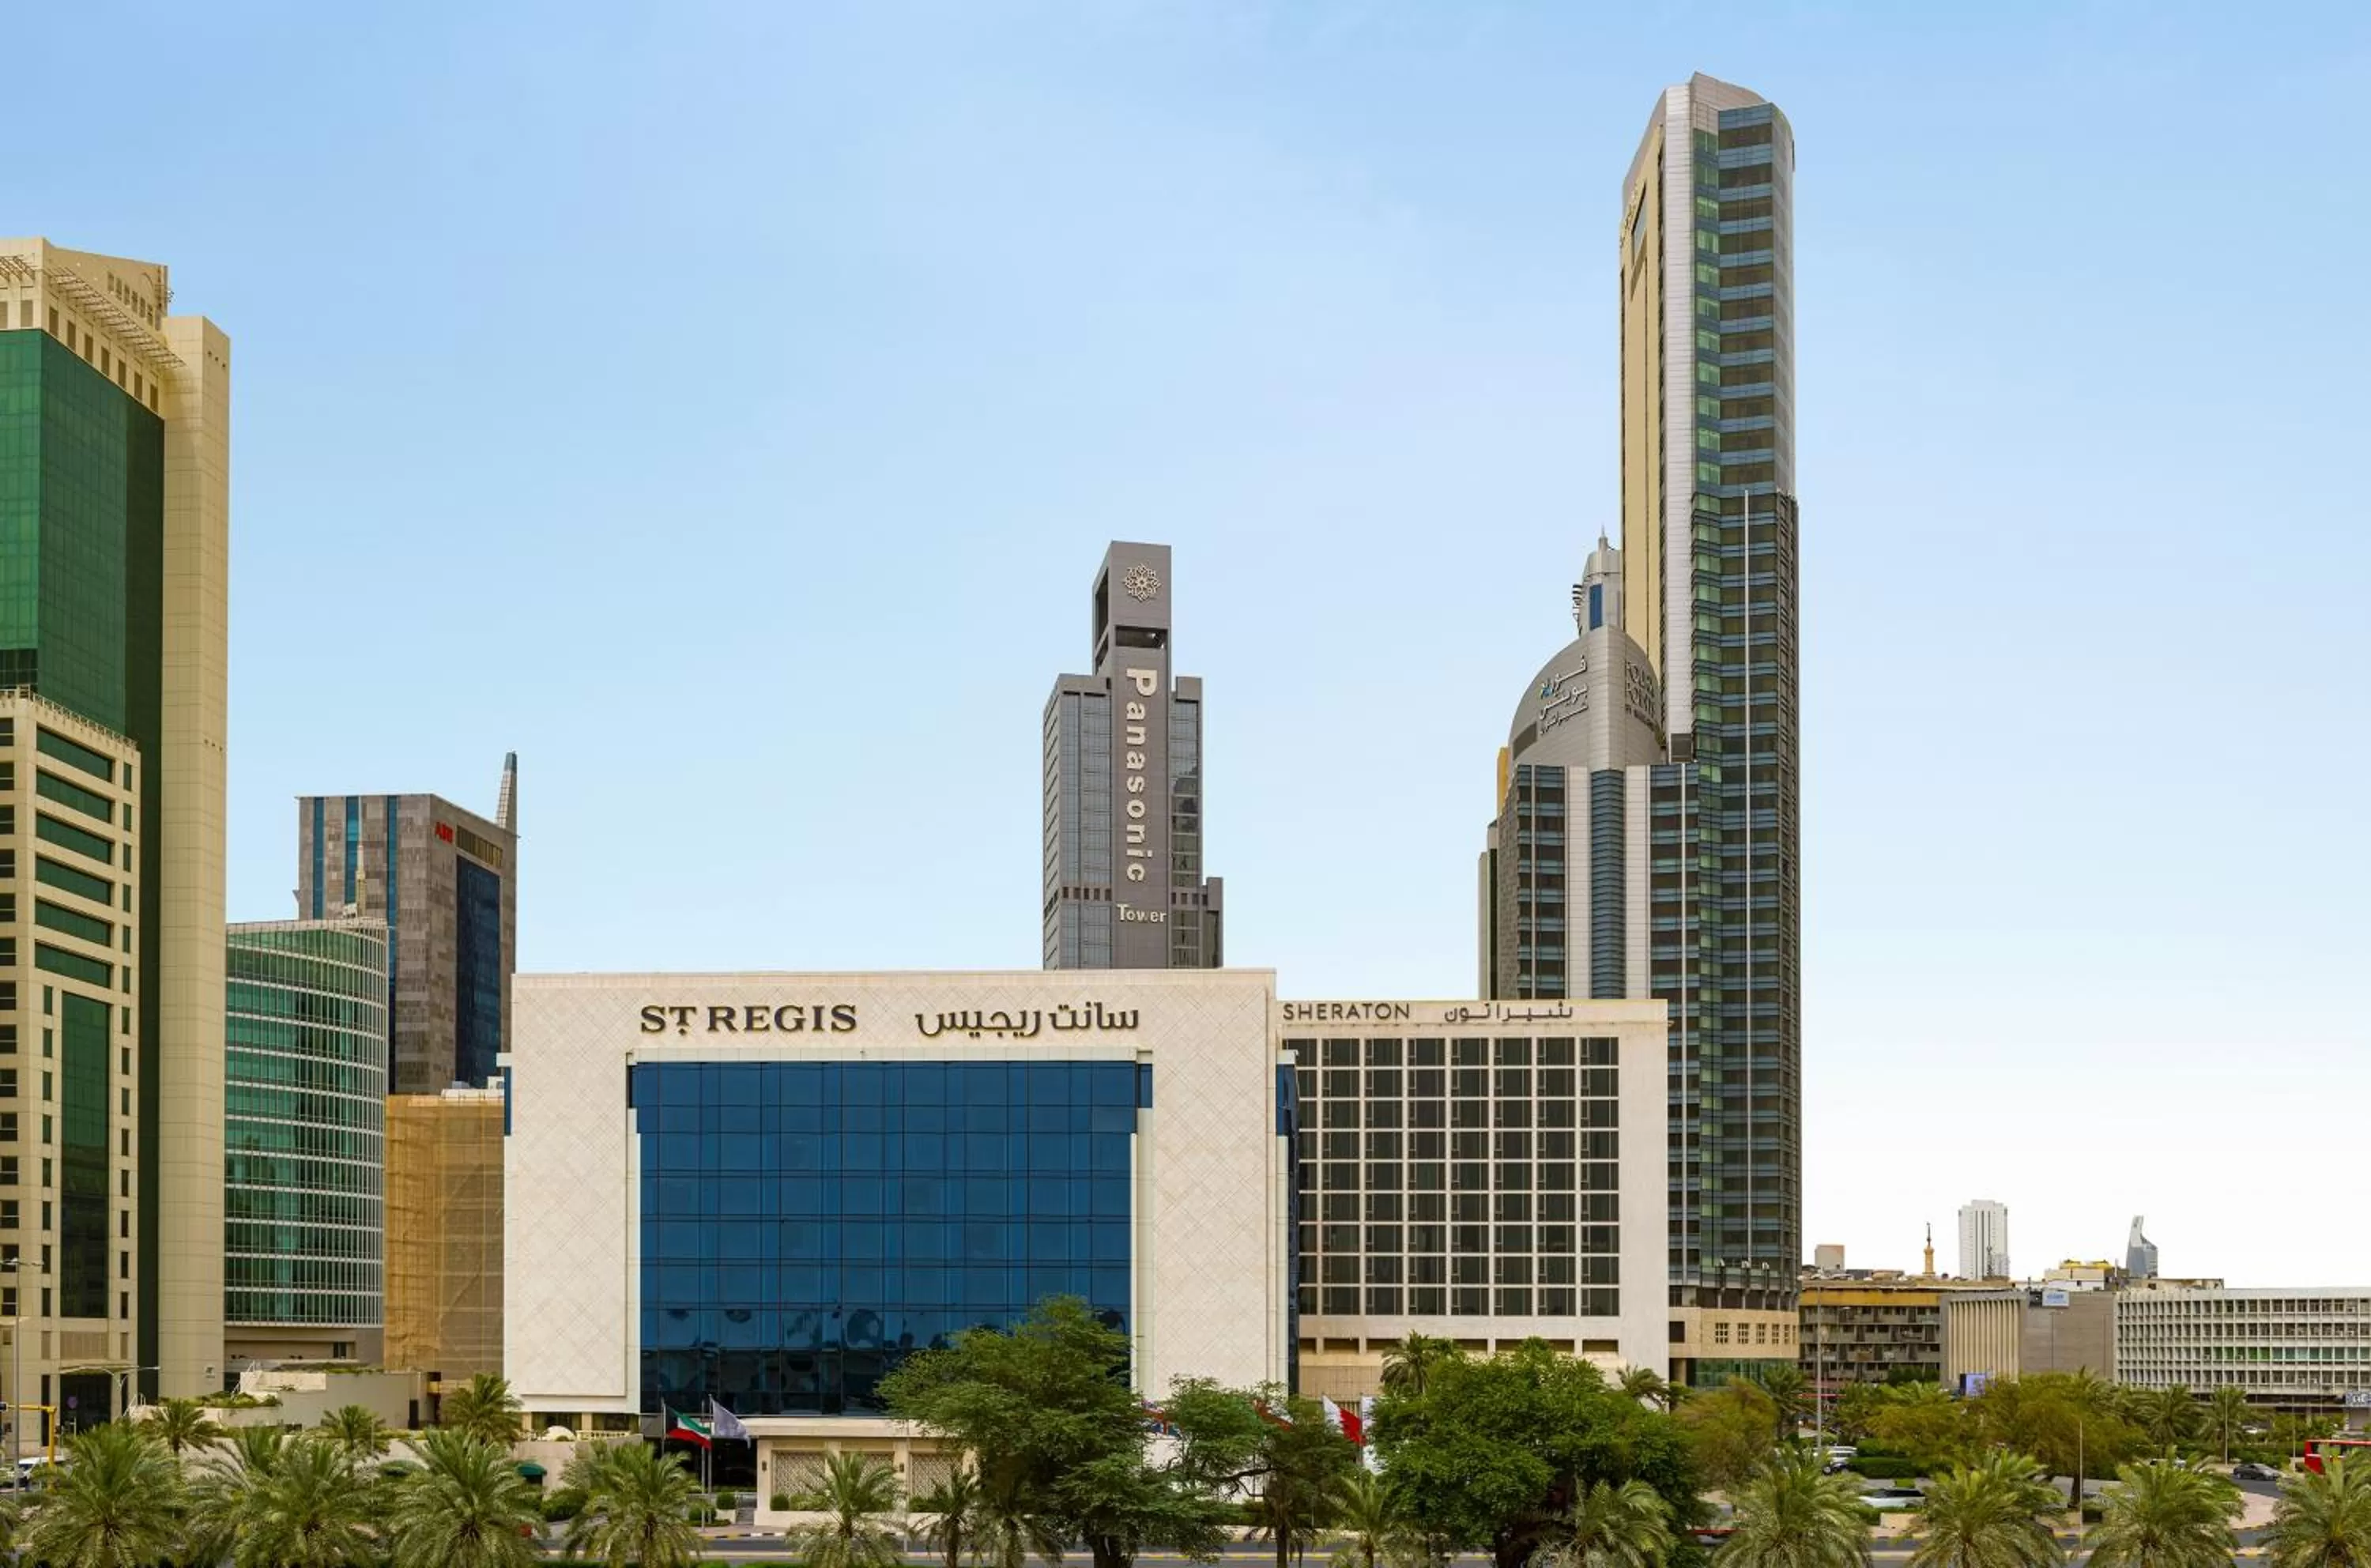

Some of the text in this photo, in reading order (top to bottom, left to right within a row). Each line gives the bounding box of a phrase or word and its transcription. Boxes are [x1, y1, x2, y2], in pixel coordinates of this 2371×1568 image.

[1126, 668, 1158, 881] Panasonic
[1116, 903, 1167, 922] Tower
[707, 1004, 858, 1033] REGIS
[914, 1001, 1140, 1038] سانت ريجيس
[1282, 1002, 1411, 1021] SHERATON
[1443, 1001, 1574, 1023] شيراتون
